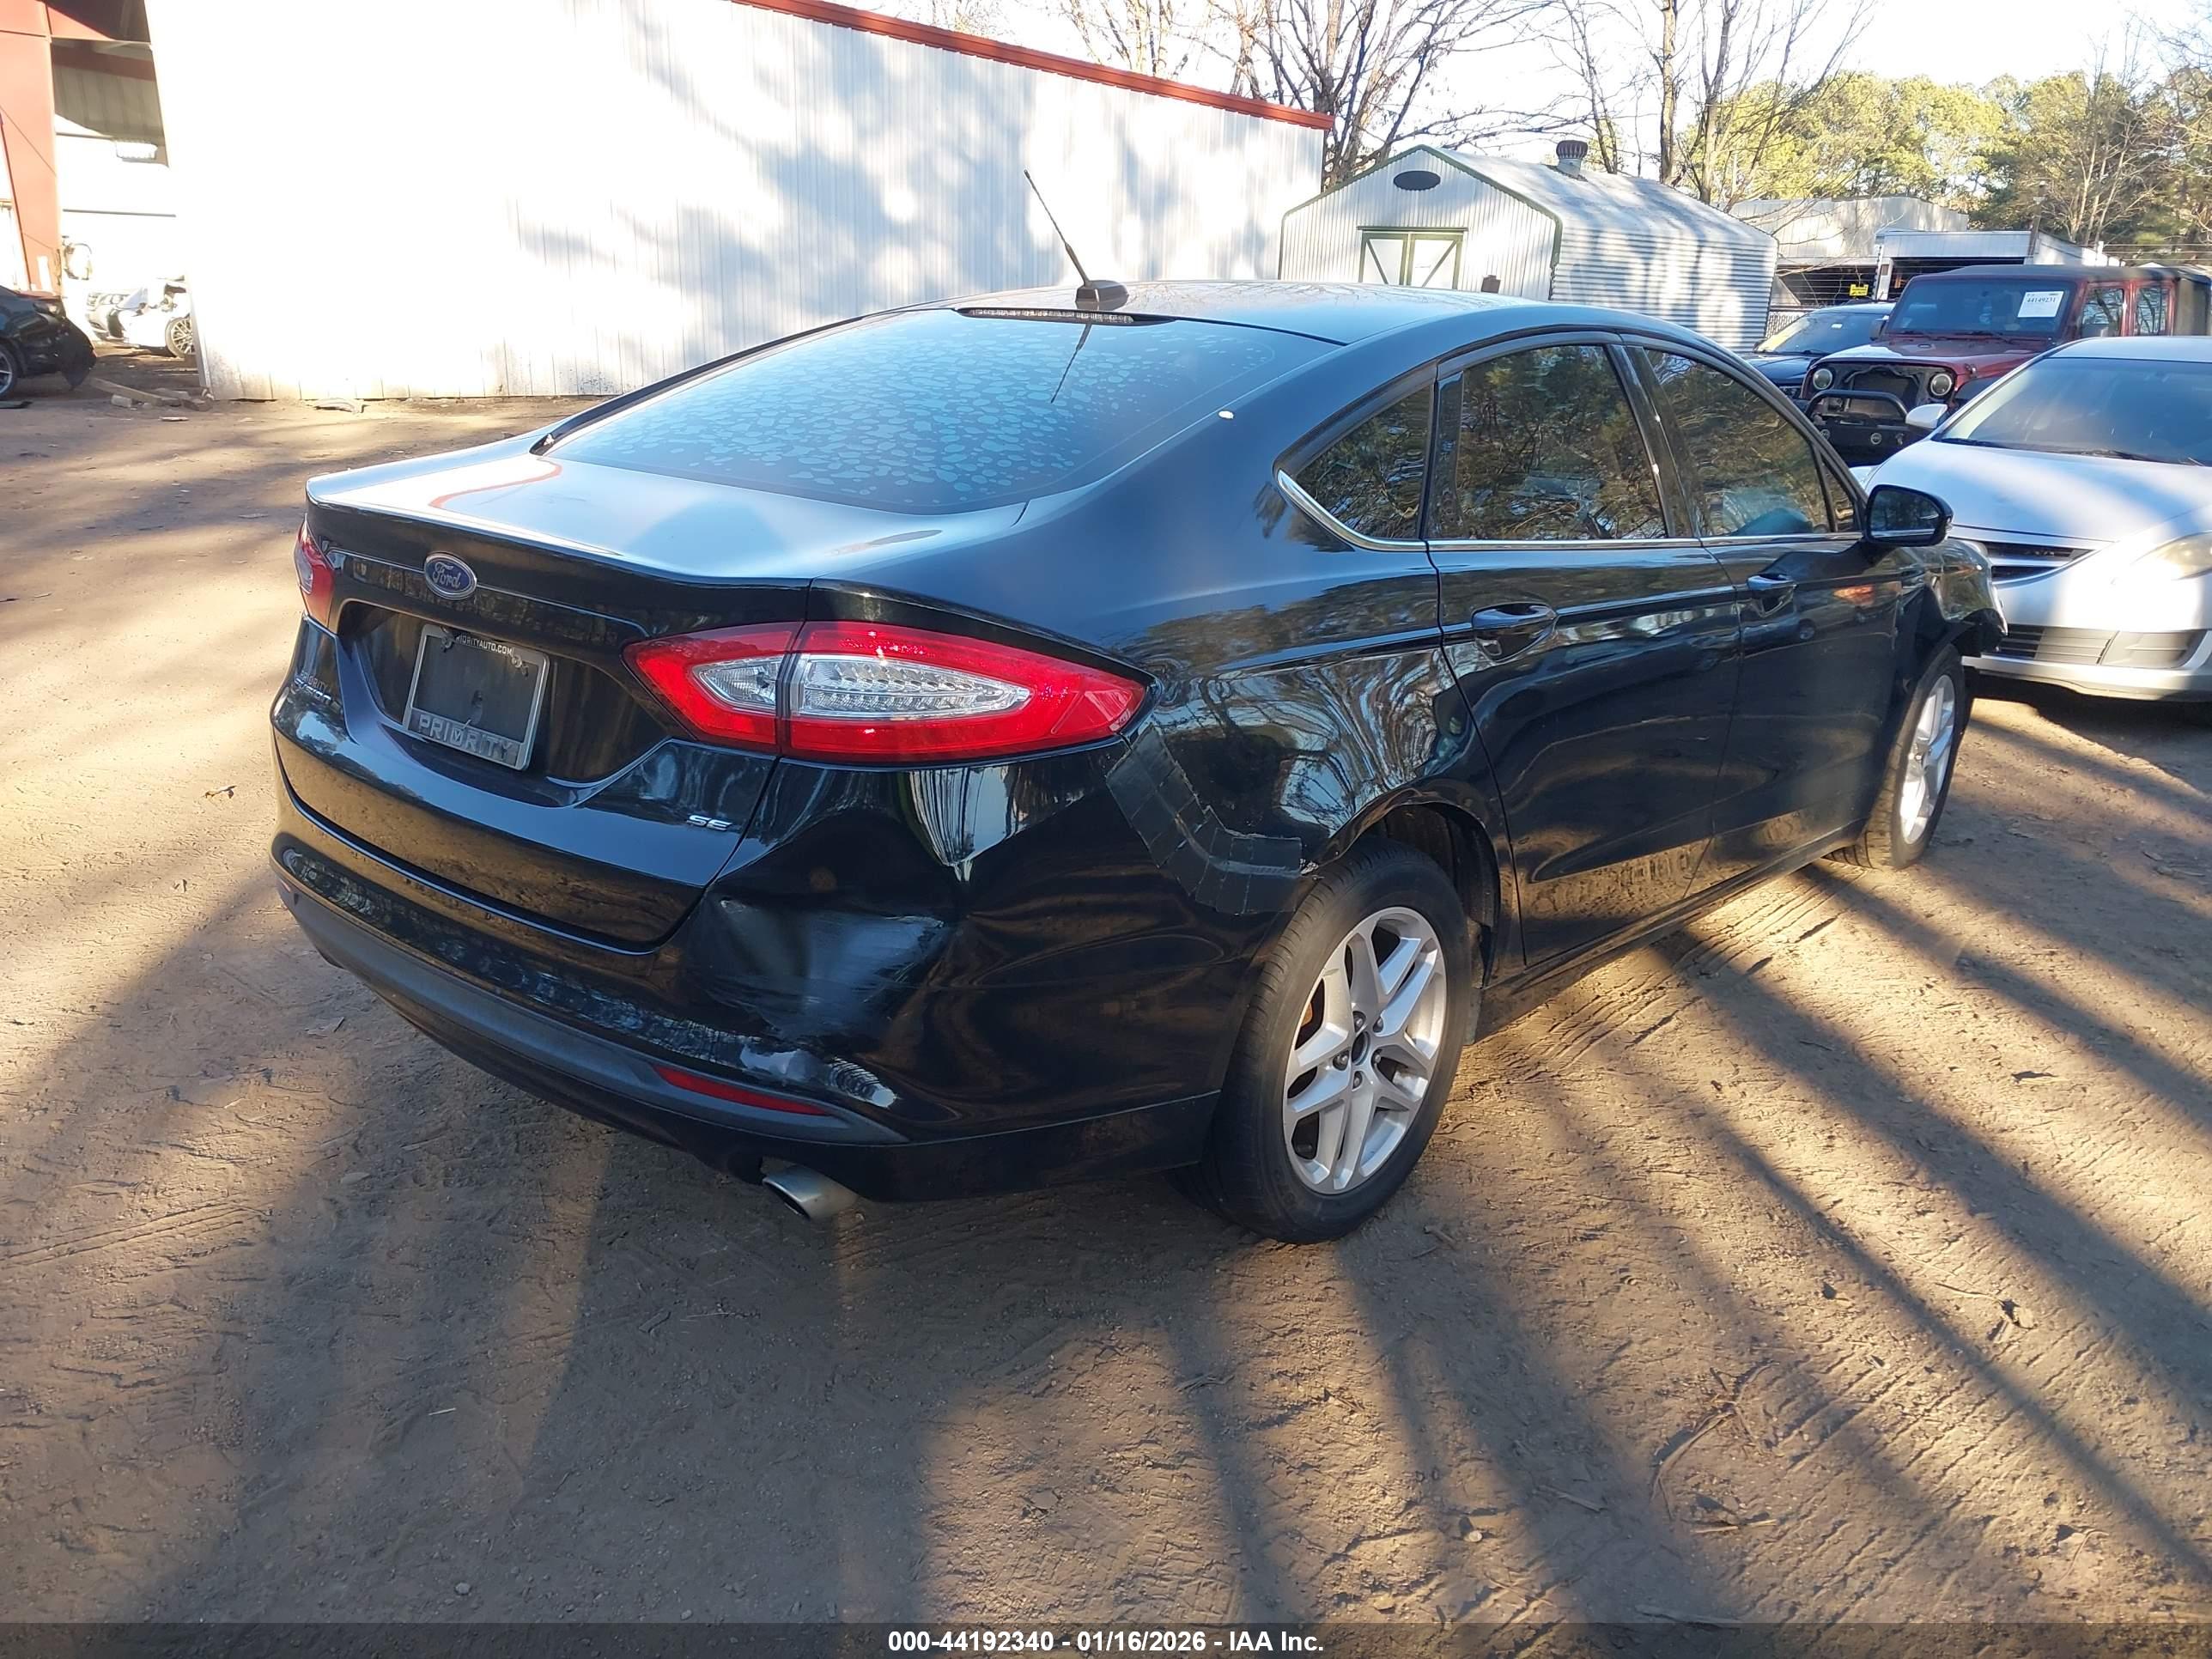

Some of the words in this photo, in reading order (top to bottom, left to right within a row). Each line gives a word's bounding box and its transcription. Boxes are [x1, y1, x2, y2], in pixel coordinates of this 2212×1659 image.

[432, 562, 462, 589] Ford
[454, 634, 514, 655] RIORITYAUTO.COM
[418, 714, 513, 758] PRIORITY
[686, 814, 733, 830] SE
